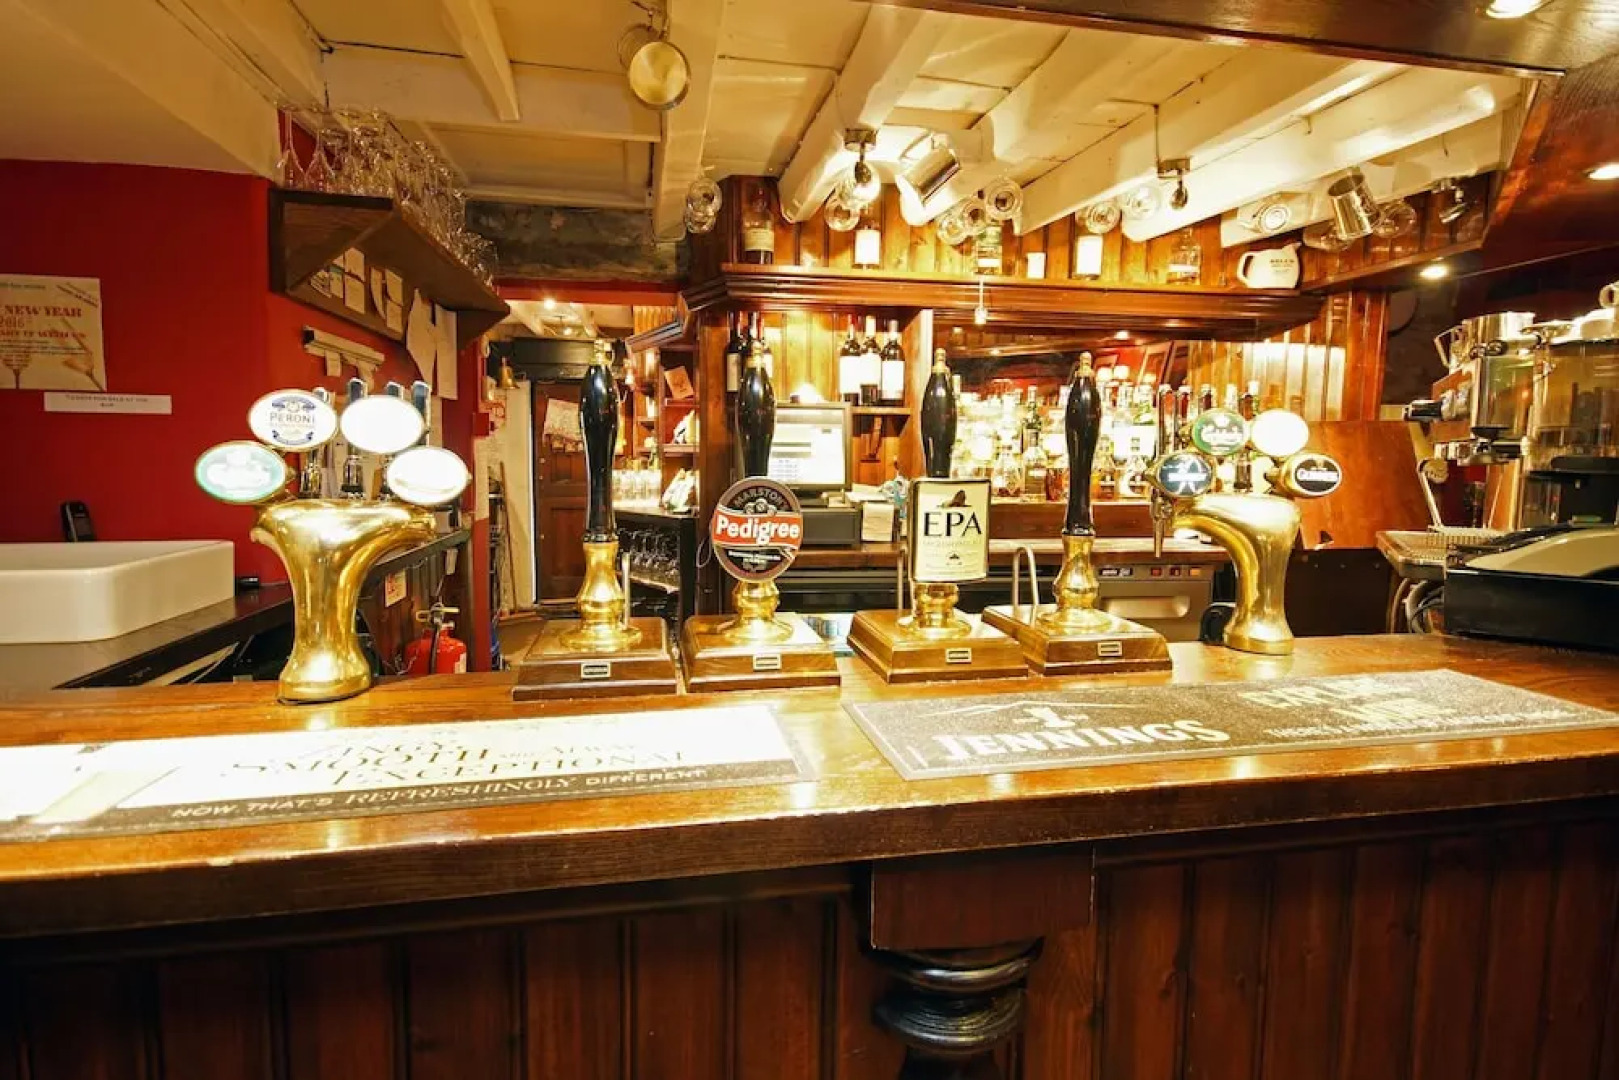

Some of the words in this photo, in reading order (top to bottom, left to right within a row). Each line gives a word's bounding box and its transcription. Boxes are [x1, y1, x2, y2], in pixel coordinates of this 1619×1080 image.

[5, 305, 40, 315] NEW
[44, 306, 82, 318] YEAR
[269, 411, 316, 424] PERONI
[716, 515, 800, 545] Pedigree
[923, 511, 982, 537] EPA
[931, 719, 1231, 761] JENNINGS
[172, 805, 237, 818] NOW
